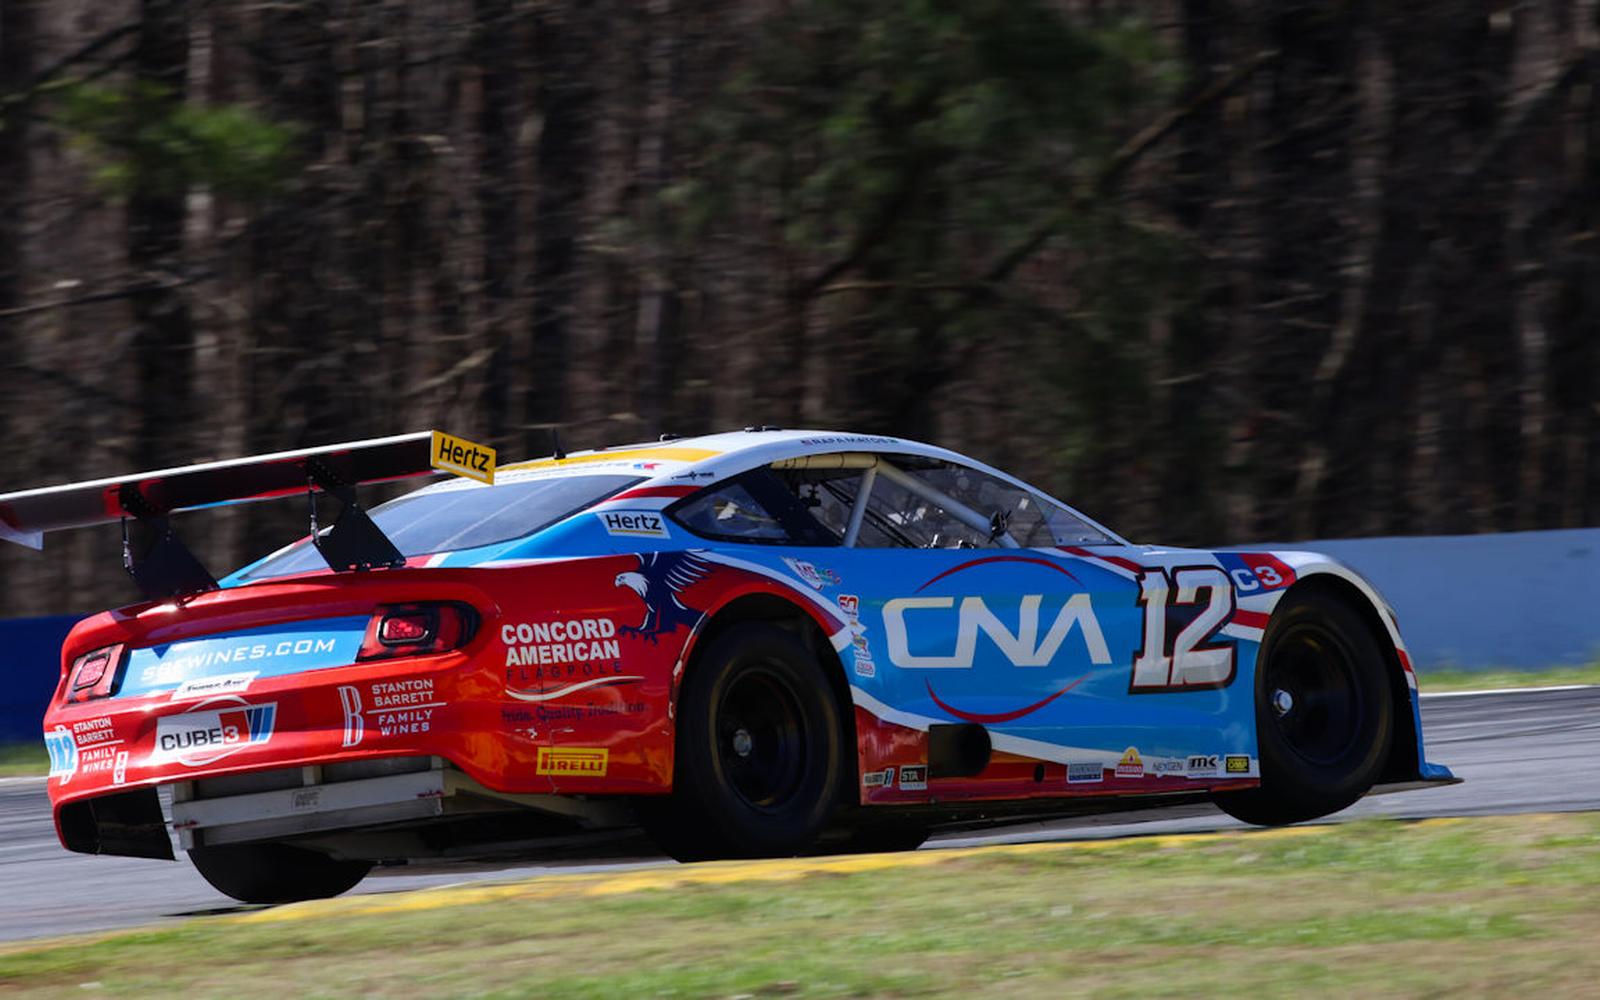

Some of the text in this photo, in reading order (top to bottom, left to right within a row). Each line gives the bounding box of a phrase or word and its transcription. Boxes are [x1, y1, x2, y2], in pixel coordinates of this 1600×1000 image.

[438, 437, 491, 472] Hertz
[605, 514, 662, 531] Hertz
[1230, 565, 1283, 592] C3
[501, 618, 616, 645] CONCORD
[882, 593, 1112, 668] CNA
[1131, 563, 1234, 689] 12
[505, 639, 621, 667] AMERICAN
[506, 660, 623, 681] FLAGPOLE
[371, 679, 434, 695] STANTON
[374, 691, 434, 707] BARRETT
[73, 717, 112, 733] STANTON
[378, 709, 433, 726] FAMILY
[76, 729, 115, 745] BARRETT
[160, 725, 240, 751] CUBE3
[380, 721, 430, 737] WINES
[82, 747, 116, 762] FAMILY
[541, 752, 605, 772] PIRELLI
[82, 759, 114, 774] WINES
